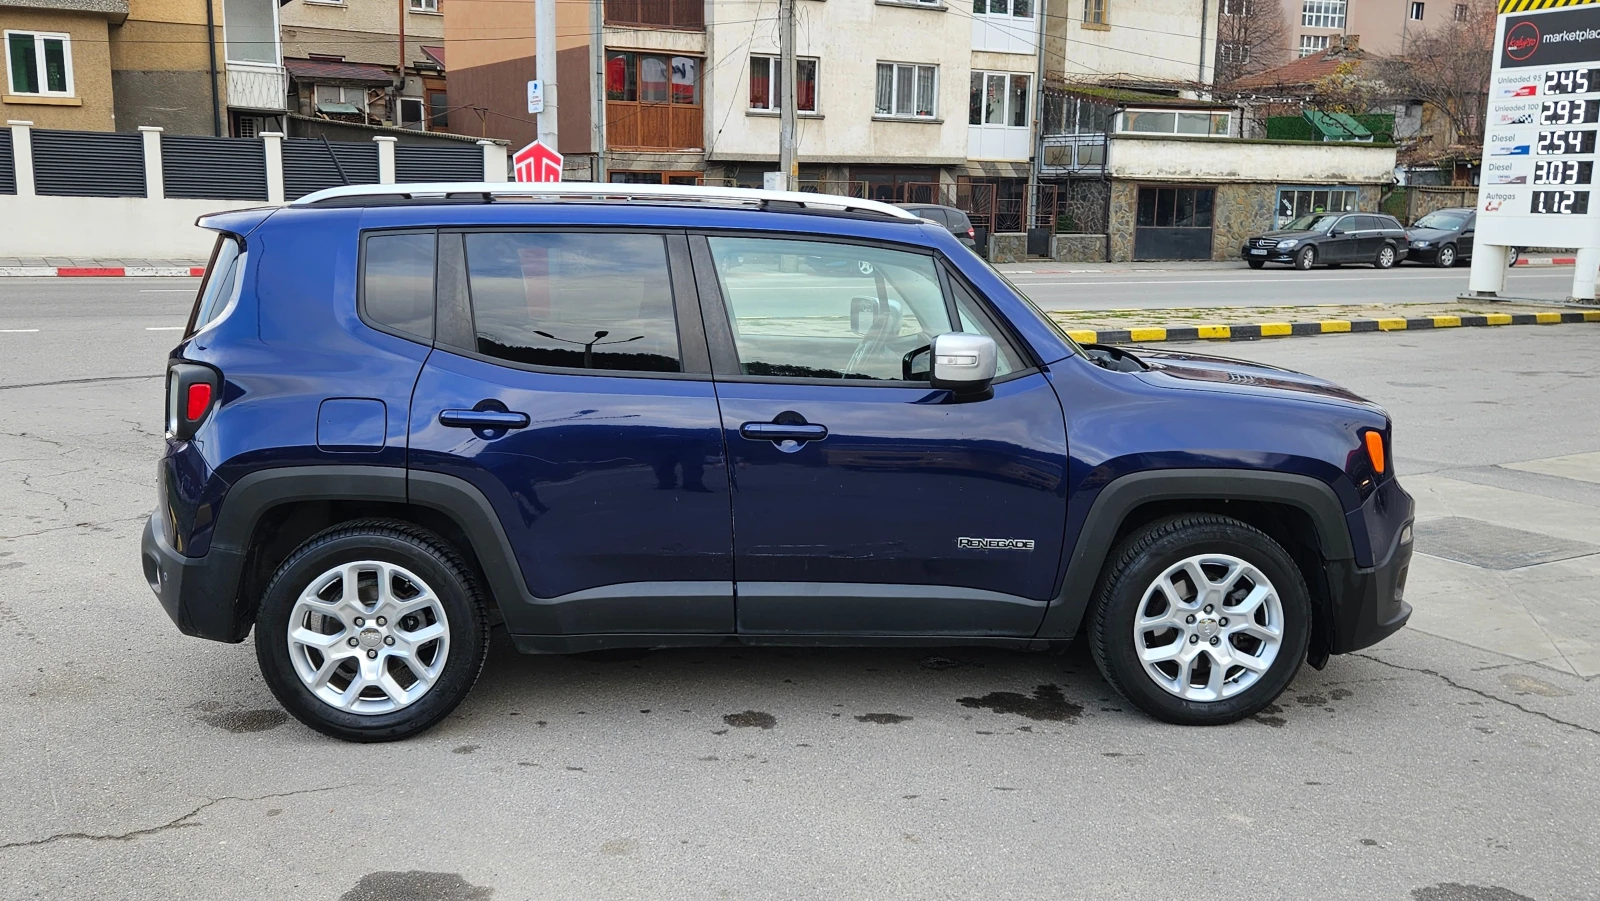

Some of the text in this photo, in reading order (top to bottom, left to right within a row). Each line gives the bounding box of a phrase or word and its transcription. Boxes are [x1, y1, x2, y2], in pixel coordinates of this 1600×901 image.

[1497, 75, 1531, 84] Unleaded
[1544, 68, 1589, 95] 2.45
[1494, 104, 1526, 112] Unleaded
[1541, 99, 1586, 125] 2.93
[1491, 133, 1516, 143] Diesel
[1537, 130, 1582, 155] 2.54
[1488, 162, 1513, 171] Diesel
[1534, 160, 1579, 185] 3.03
[1485, 192, 1516, 202] Autogas
[1538, 190, 1575, 214] 1.12
[957, 537, 1035, 550] RENEGADE
